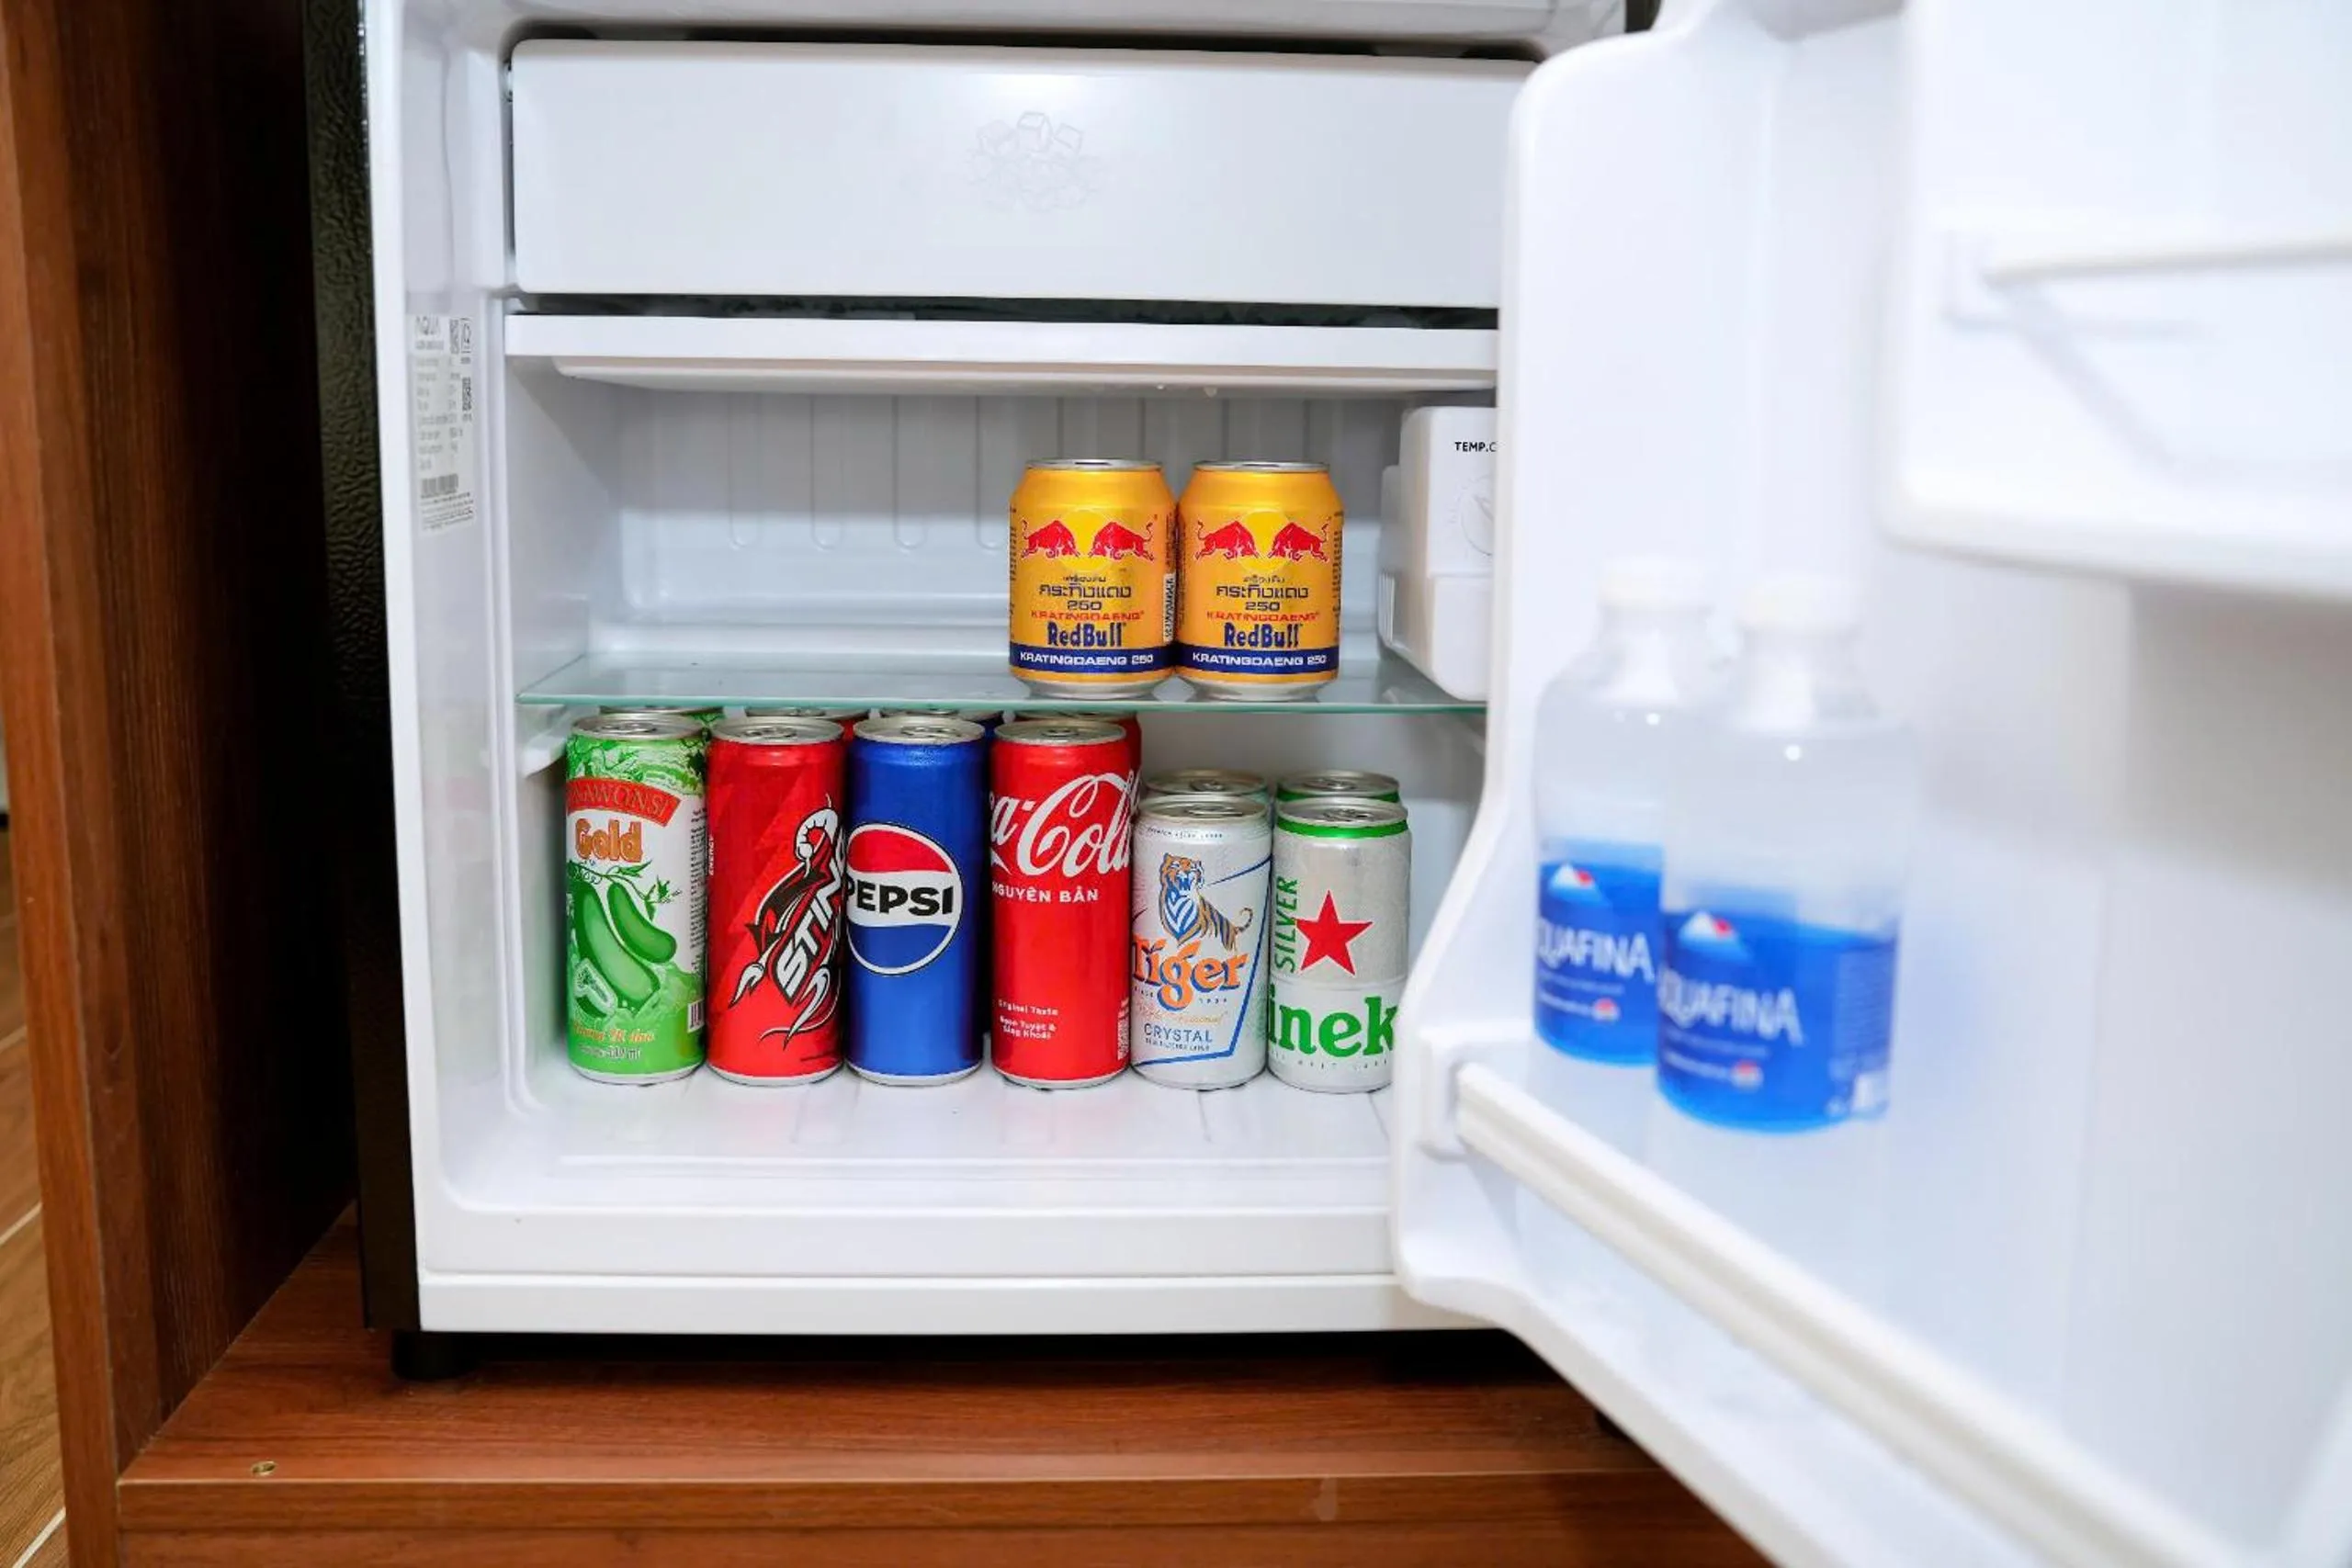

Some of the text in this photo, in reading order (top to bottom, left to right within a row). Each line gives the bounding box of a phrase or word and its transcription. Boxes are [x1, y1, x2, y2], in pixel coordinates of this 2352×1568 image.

[1067, 601, 1102, 611] 250
[1245, 602, 1281, 611] 250
[1019, 651, 1154, 667] KRATINGDAENG 250
[1193, 652, 1328, 667] KRATINGDAENG 250
[575, 818, 644, 863] Gold
[1274, 875, 1297, 973] SILVER
[1131, 936, 1249, 1011] Tiger
[1144, 1023, 1213, 1043] CRYSTAL
